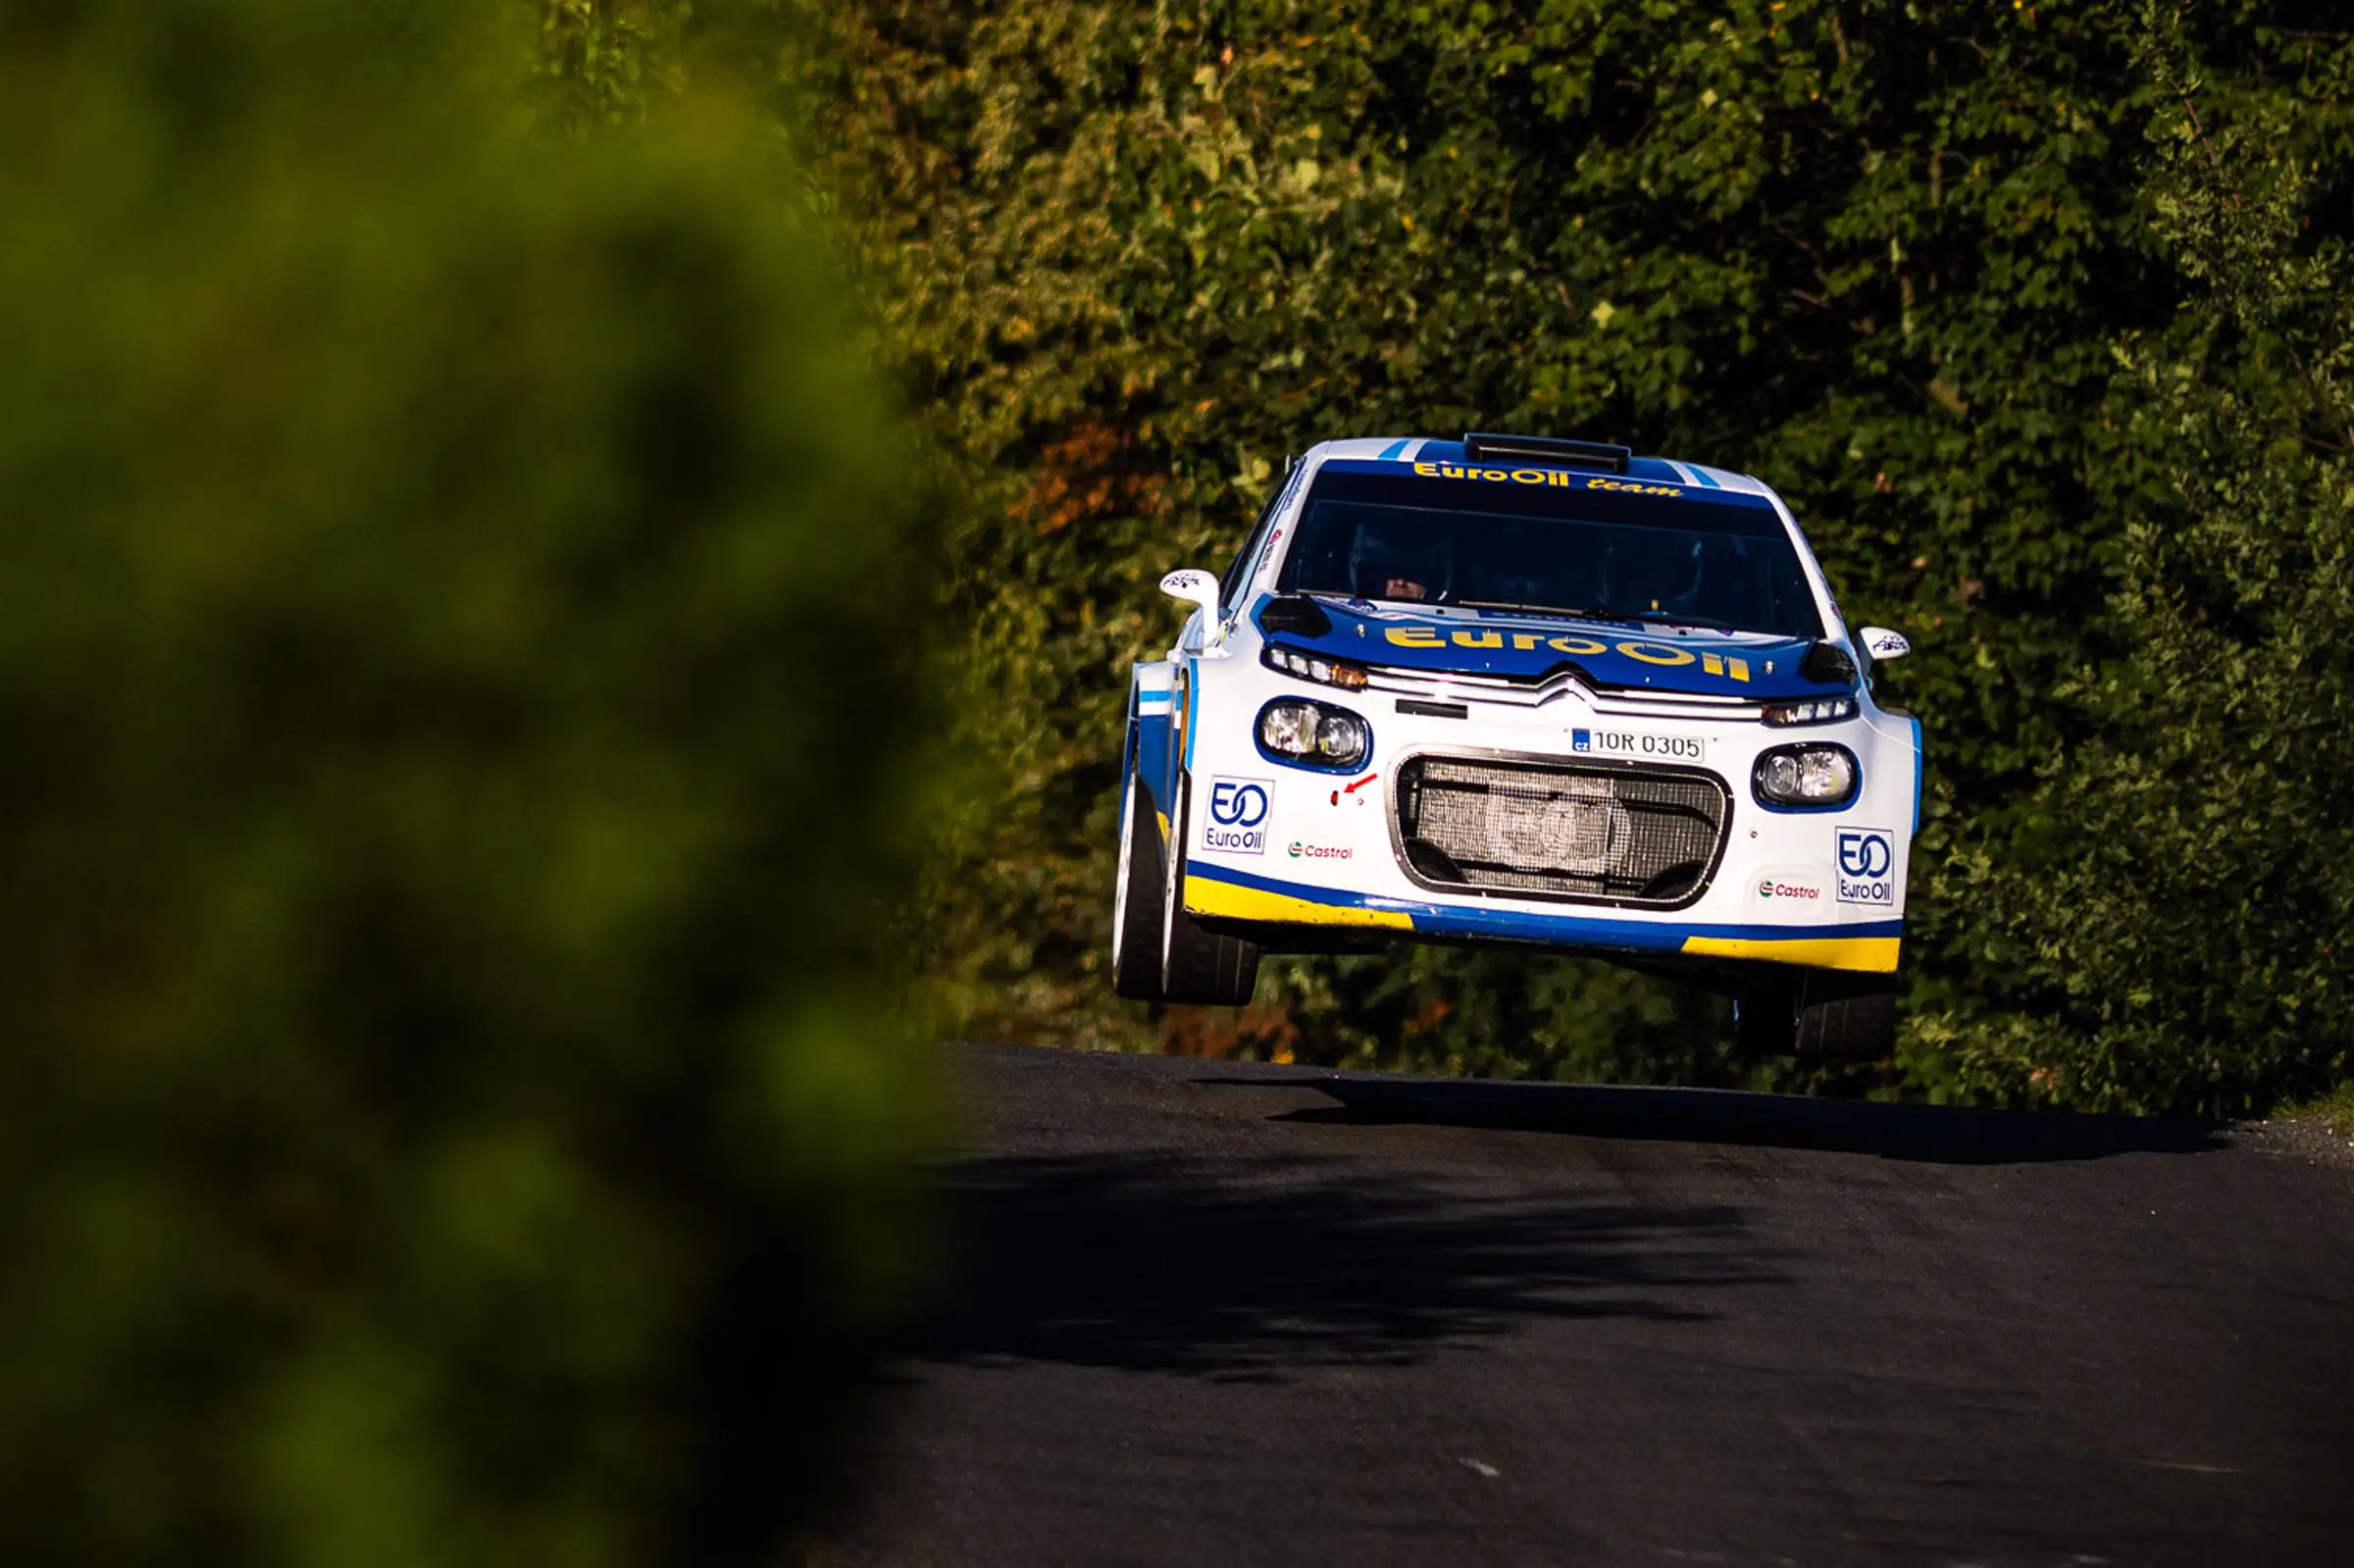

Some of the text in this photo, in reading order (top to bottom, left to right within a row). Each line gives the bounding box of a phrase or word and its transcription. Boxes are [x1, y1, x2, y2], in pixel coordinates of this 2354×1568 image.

[1586, 479, 1684, 498] team
[1594, 732, 1635, 752] 10R
[1642, 735, 1700, 758] 0305
[1305, 844, 1354, 860] Castrol
[1775, 884, 1820, 899] Castrol
